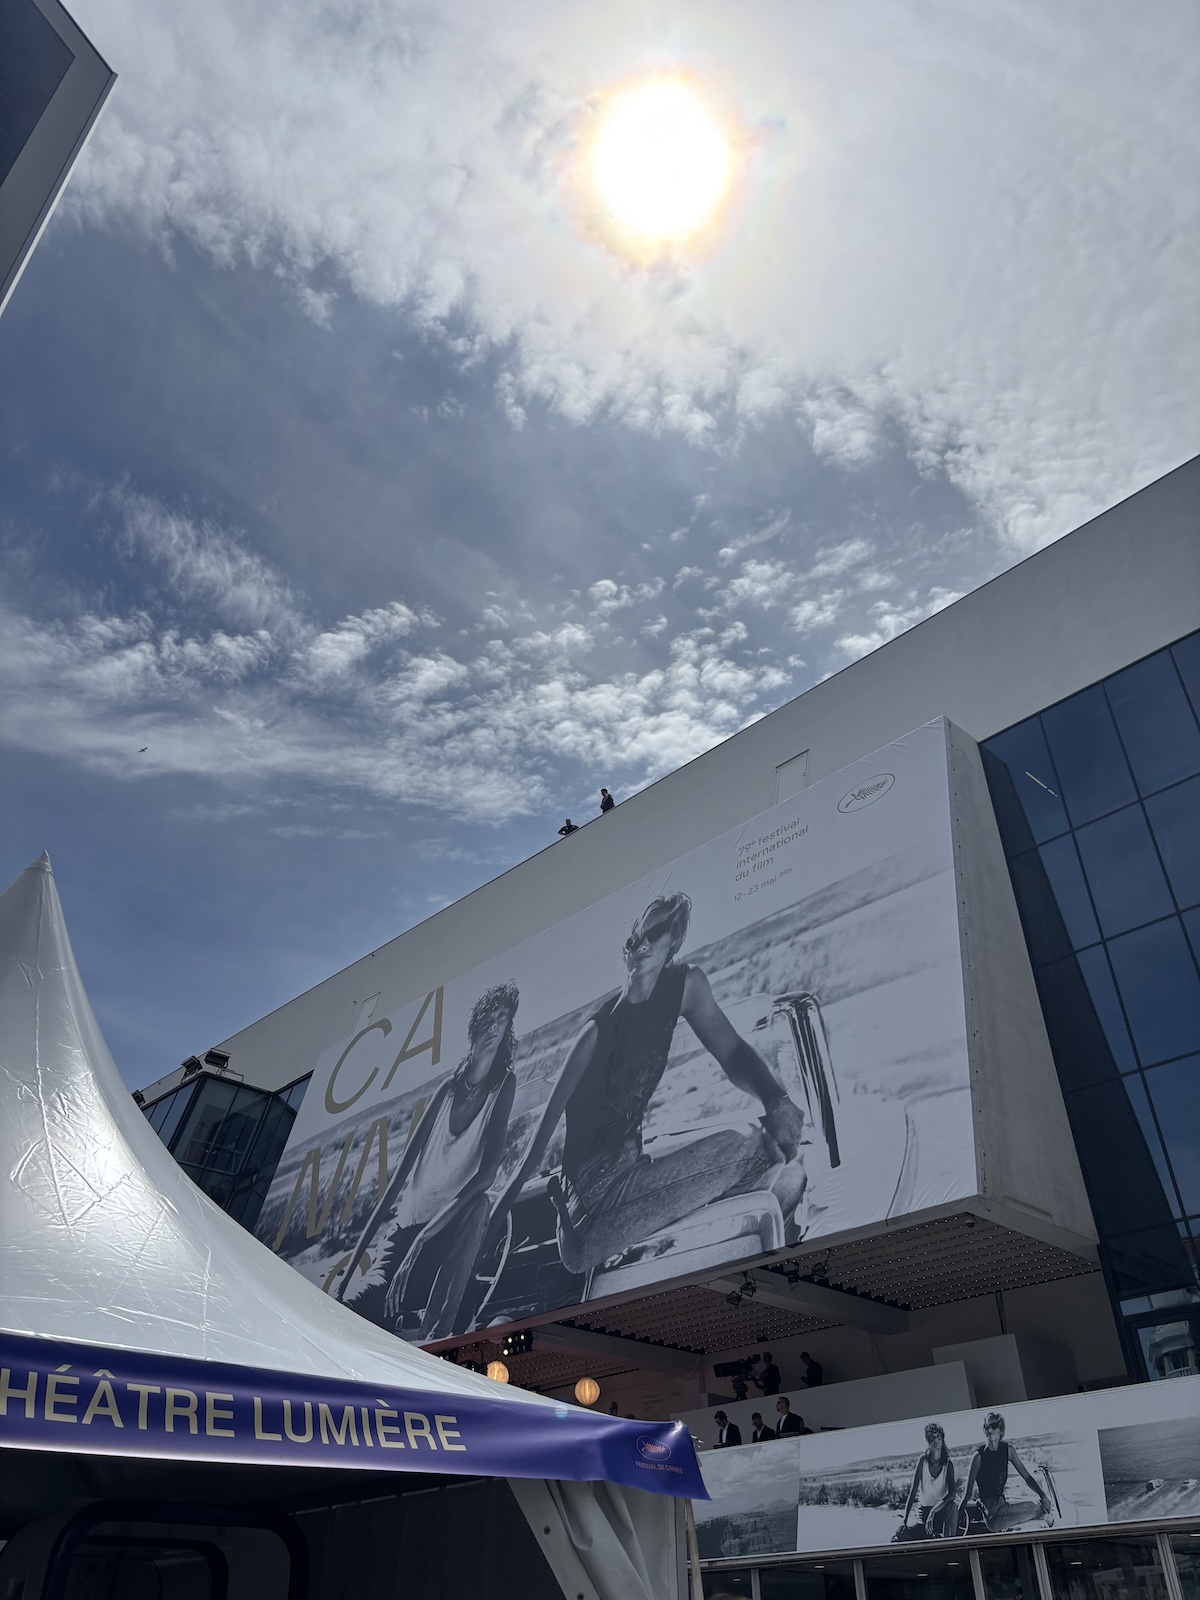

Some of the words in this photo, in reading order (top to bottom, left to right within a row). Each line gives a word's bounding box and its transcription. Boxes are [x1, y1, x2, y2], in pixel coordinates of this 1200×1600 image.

[758, 817, 800, 845] festival
[736, 824, 809, 869] international
[735, 869, 749, 882] du
[752, 857, 774, 872] film
[760, 875, 777, 889] mai
[253, 1396, 468, 1452] LUMIÈRE
